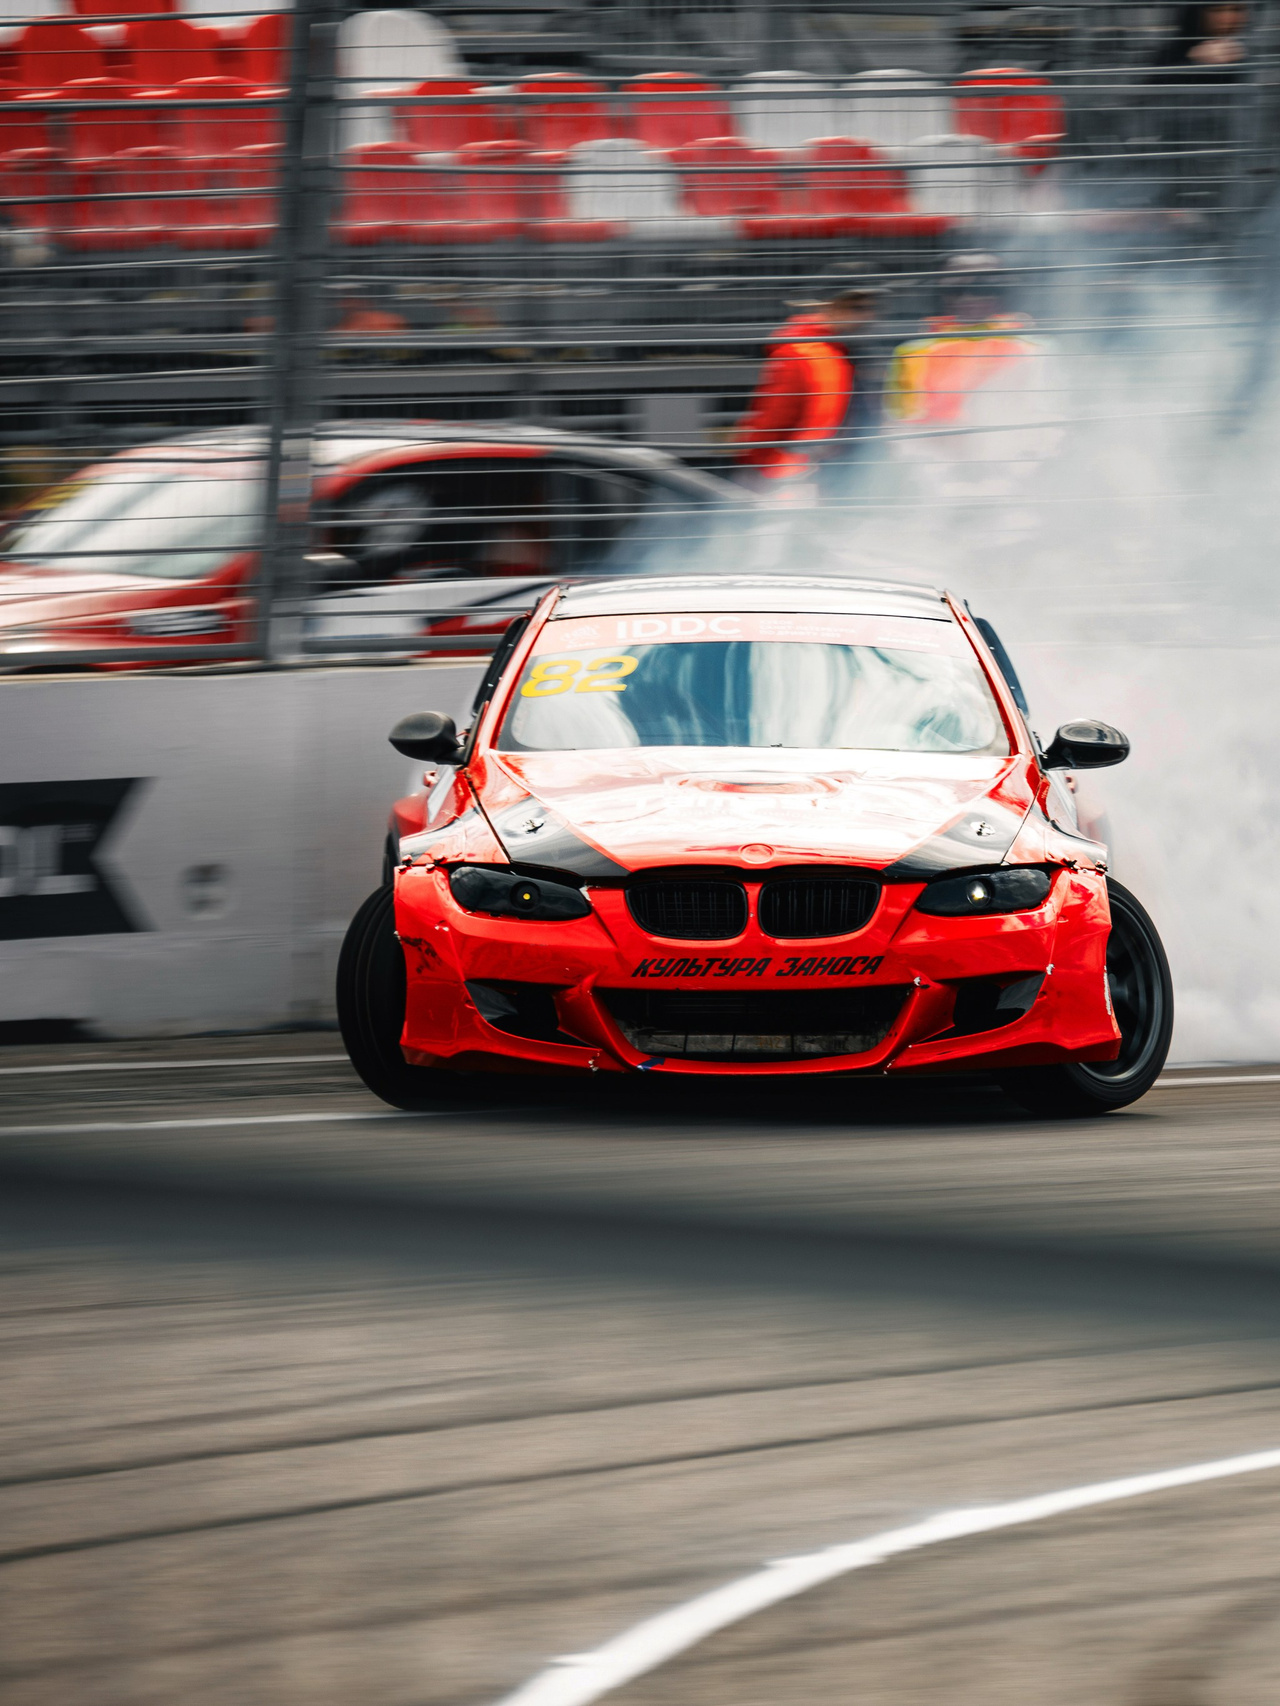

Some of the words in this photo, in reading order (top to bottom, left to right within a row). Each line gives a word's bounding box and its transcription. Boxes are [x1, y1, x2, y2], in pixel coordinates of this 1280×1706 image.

[616, 616, 742, 639] IDDC
[520, 655, 639, 698] 82
[631, 957, 772, 978] КУЛЬТУРА
[775, 955, 885, 977] ЗАНОСА
